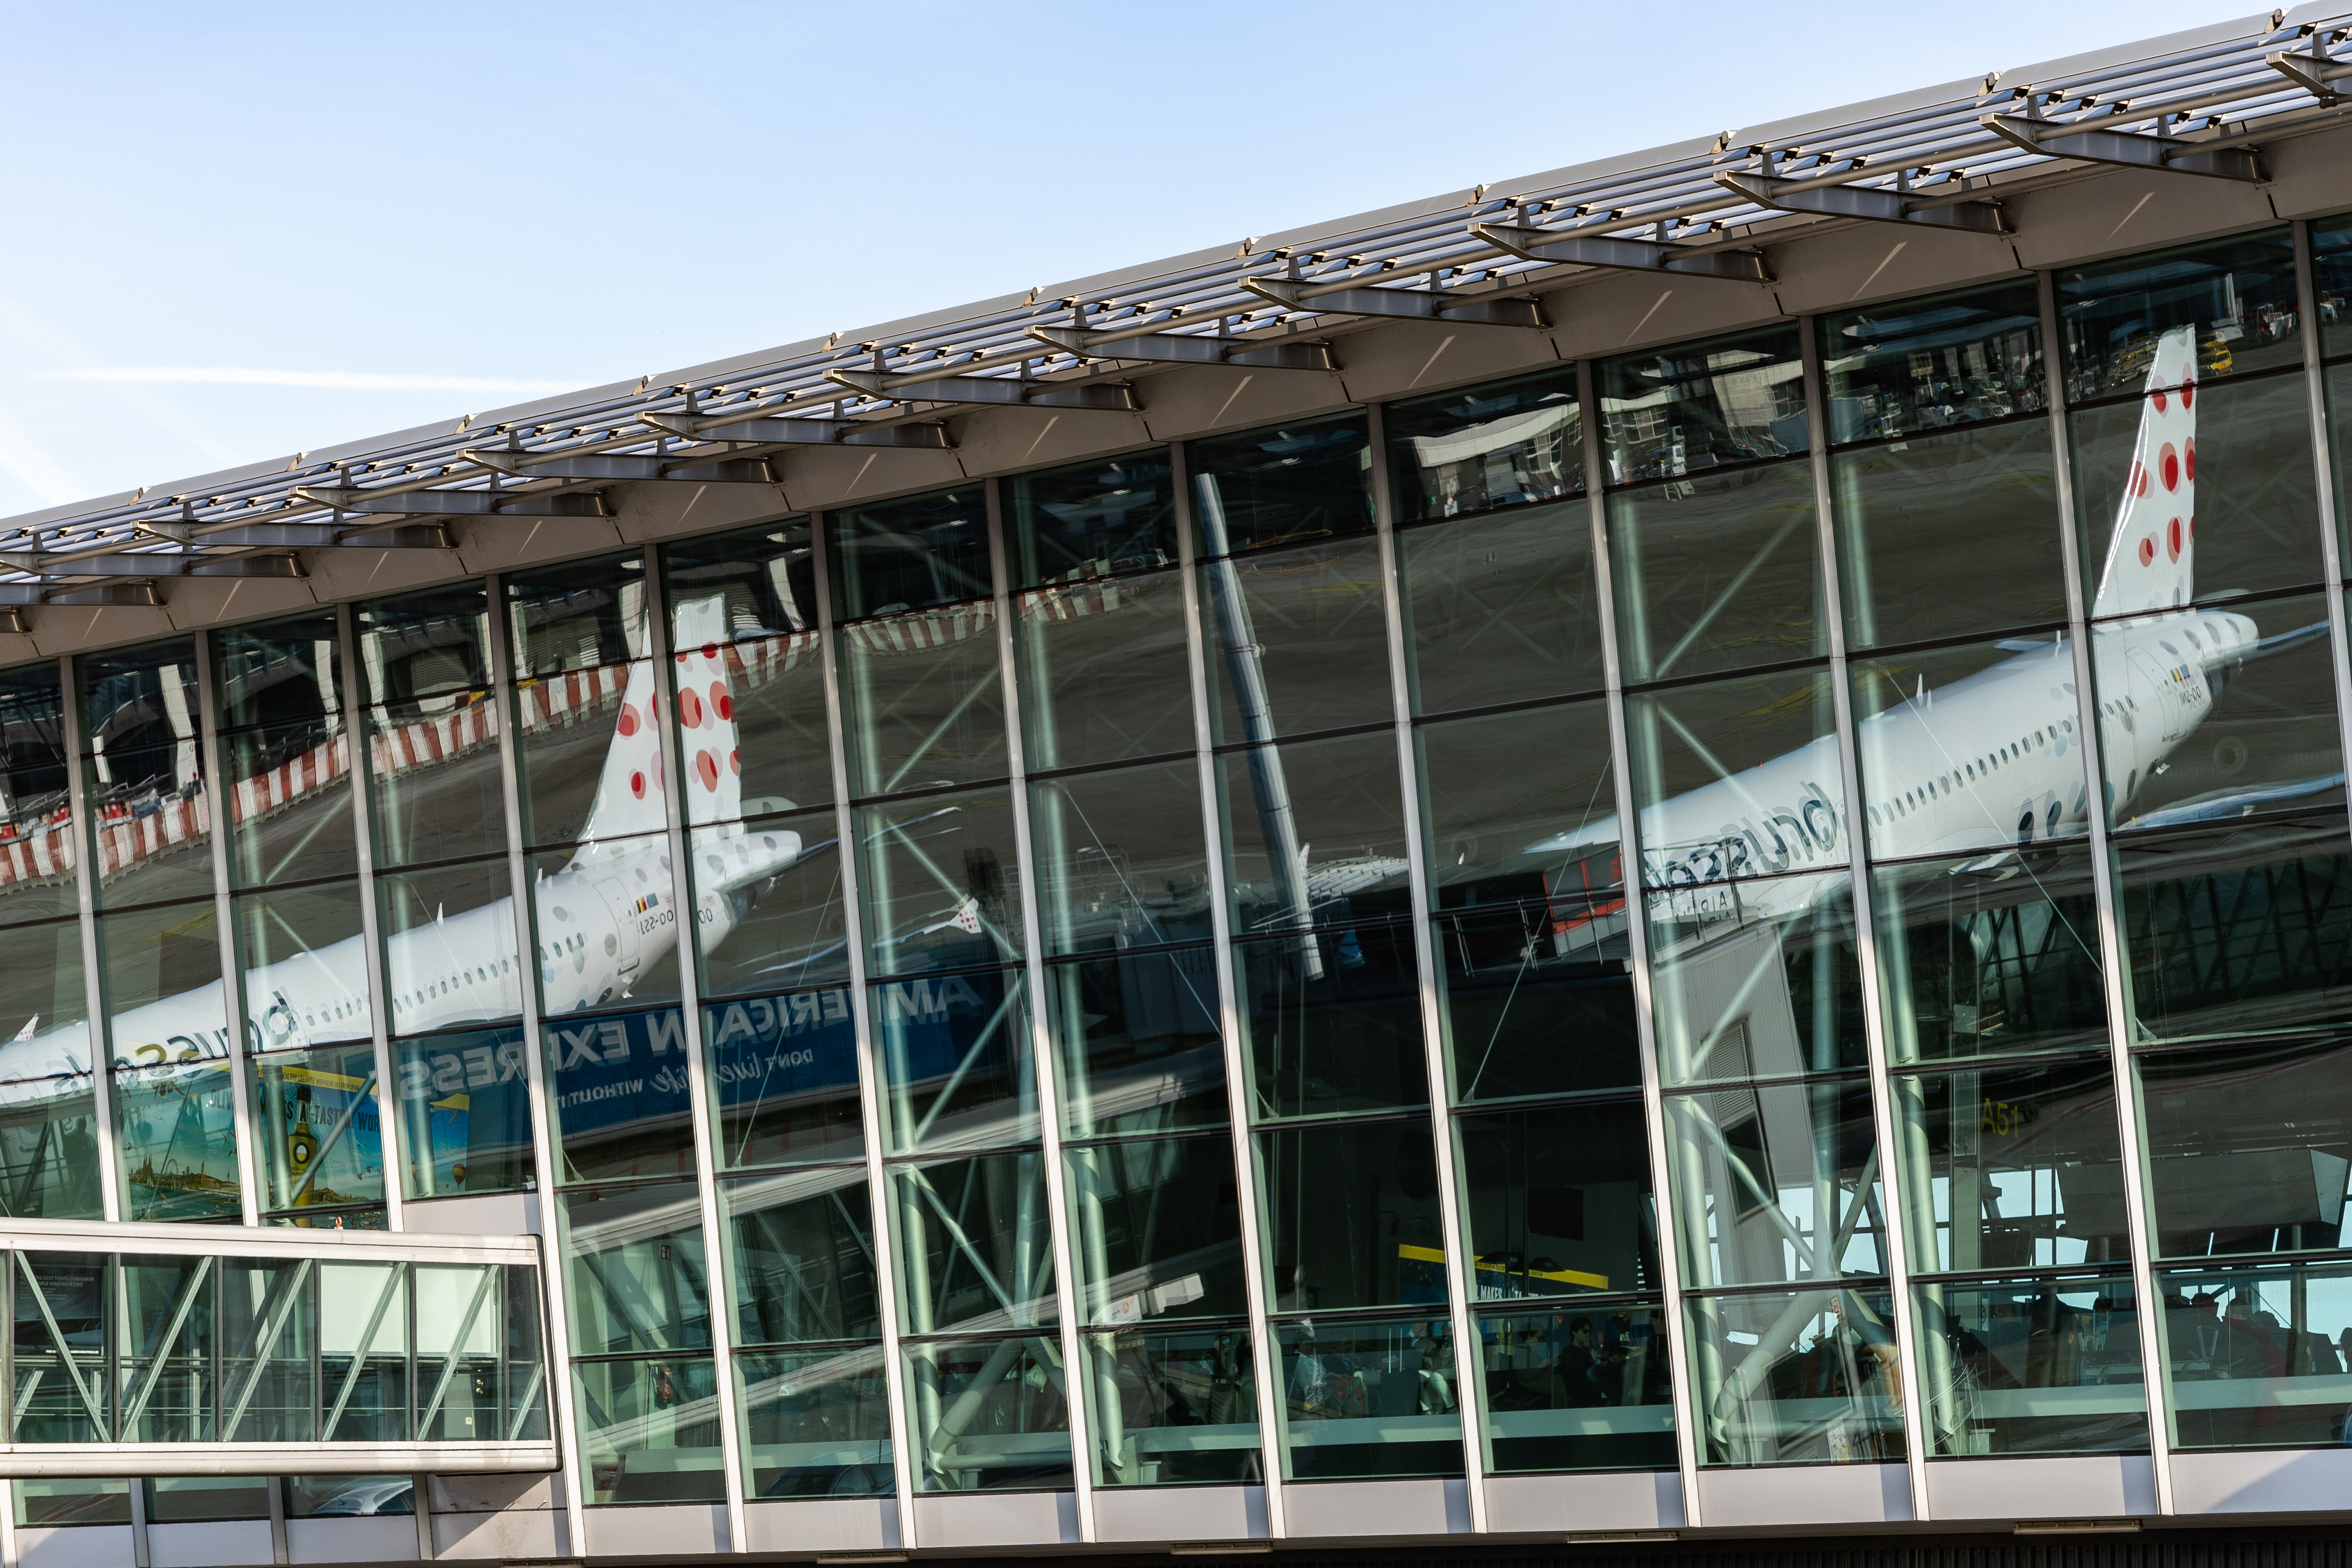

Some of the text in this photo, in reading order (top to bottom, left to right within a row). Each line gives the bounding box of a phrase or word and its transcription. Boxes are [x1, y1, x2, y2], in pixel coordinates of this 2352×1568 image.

[282, 1071, 297, 1081] EALTHY
[298, 1074, 315, 1084] LIFESTYLE
[211, 1089, 233, 1110] OLIV
[300, 1105, 307, 1122] A
[314, 1105, 354, 1129] TAST
[358, 1112, 381, 1133] WOR
[1982, 1098, 2018, 1138] A51
[1481, 1285, 1503, 1300] MAKES
